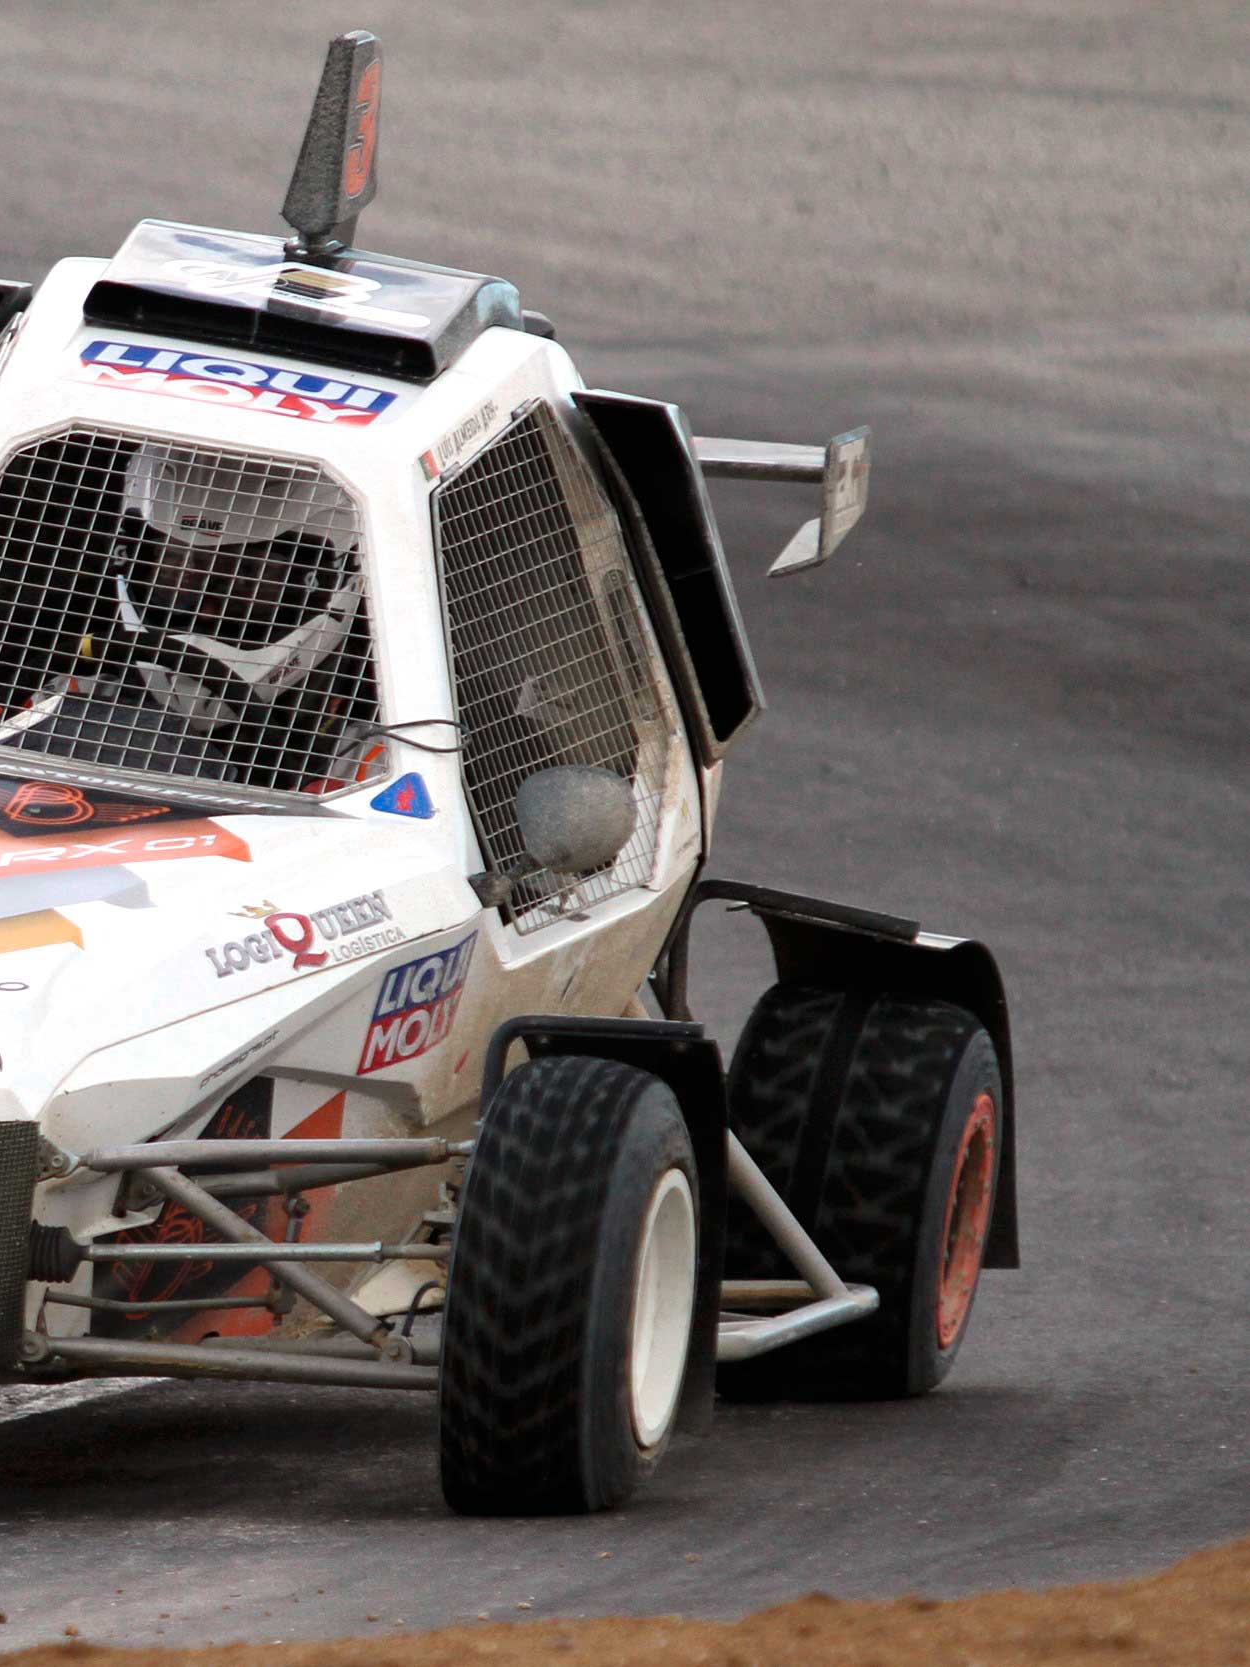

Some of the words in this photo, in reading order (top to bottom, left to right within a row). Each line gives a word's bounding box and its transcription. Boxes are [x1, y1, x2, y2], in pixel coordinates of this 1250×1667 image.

[83, 363, 371, 423] MOLY
[95, 344, 382, 408] LIQUI
[206, 889, 393, 970] LOGIQUEEN
[377, 940, 472, 1016] LIQUI
[363, 988, 463, 1070] MOLY
